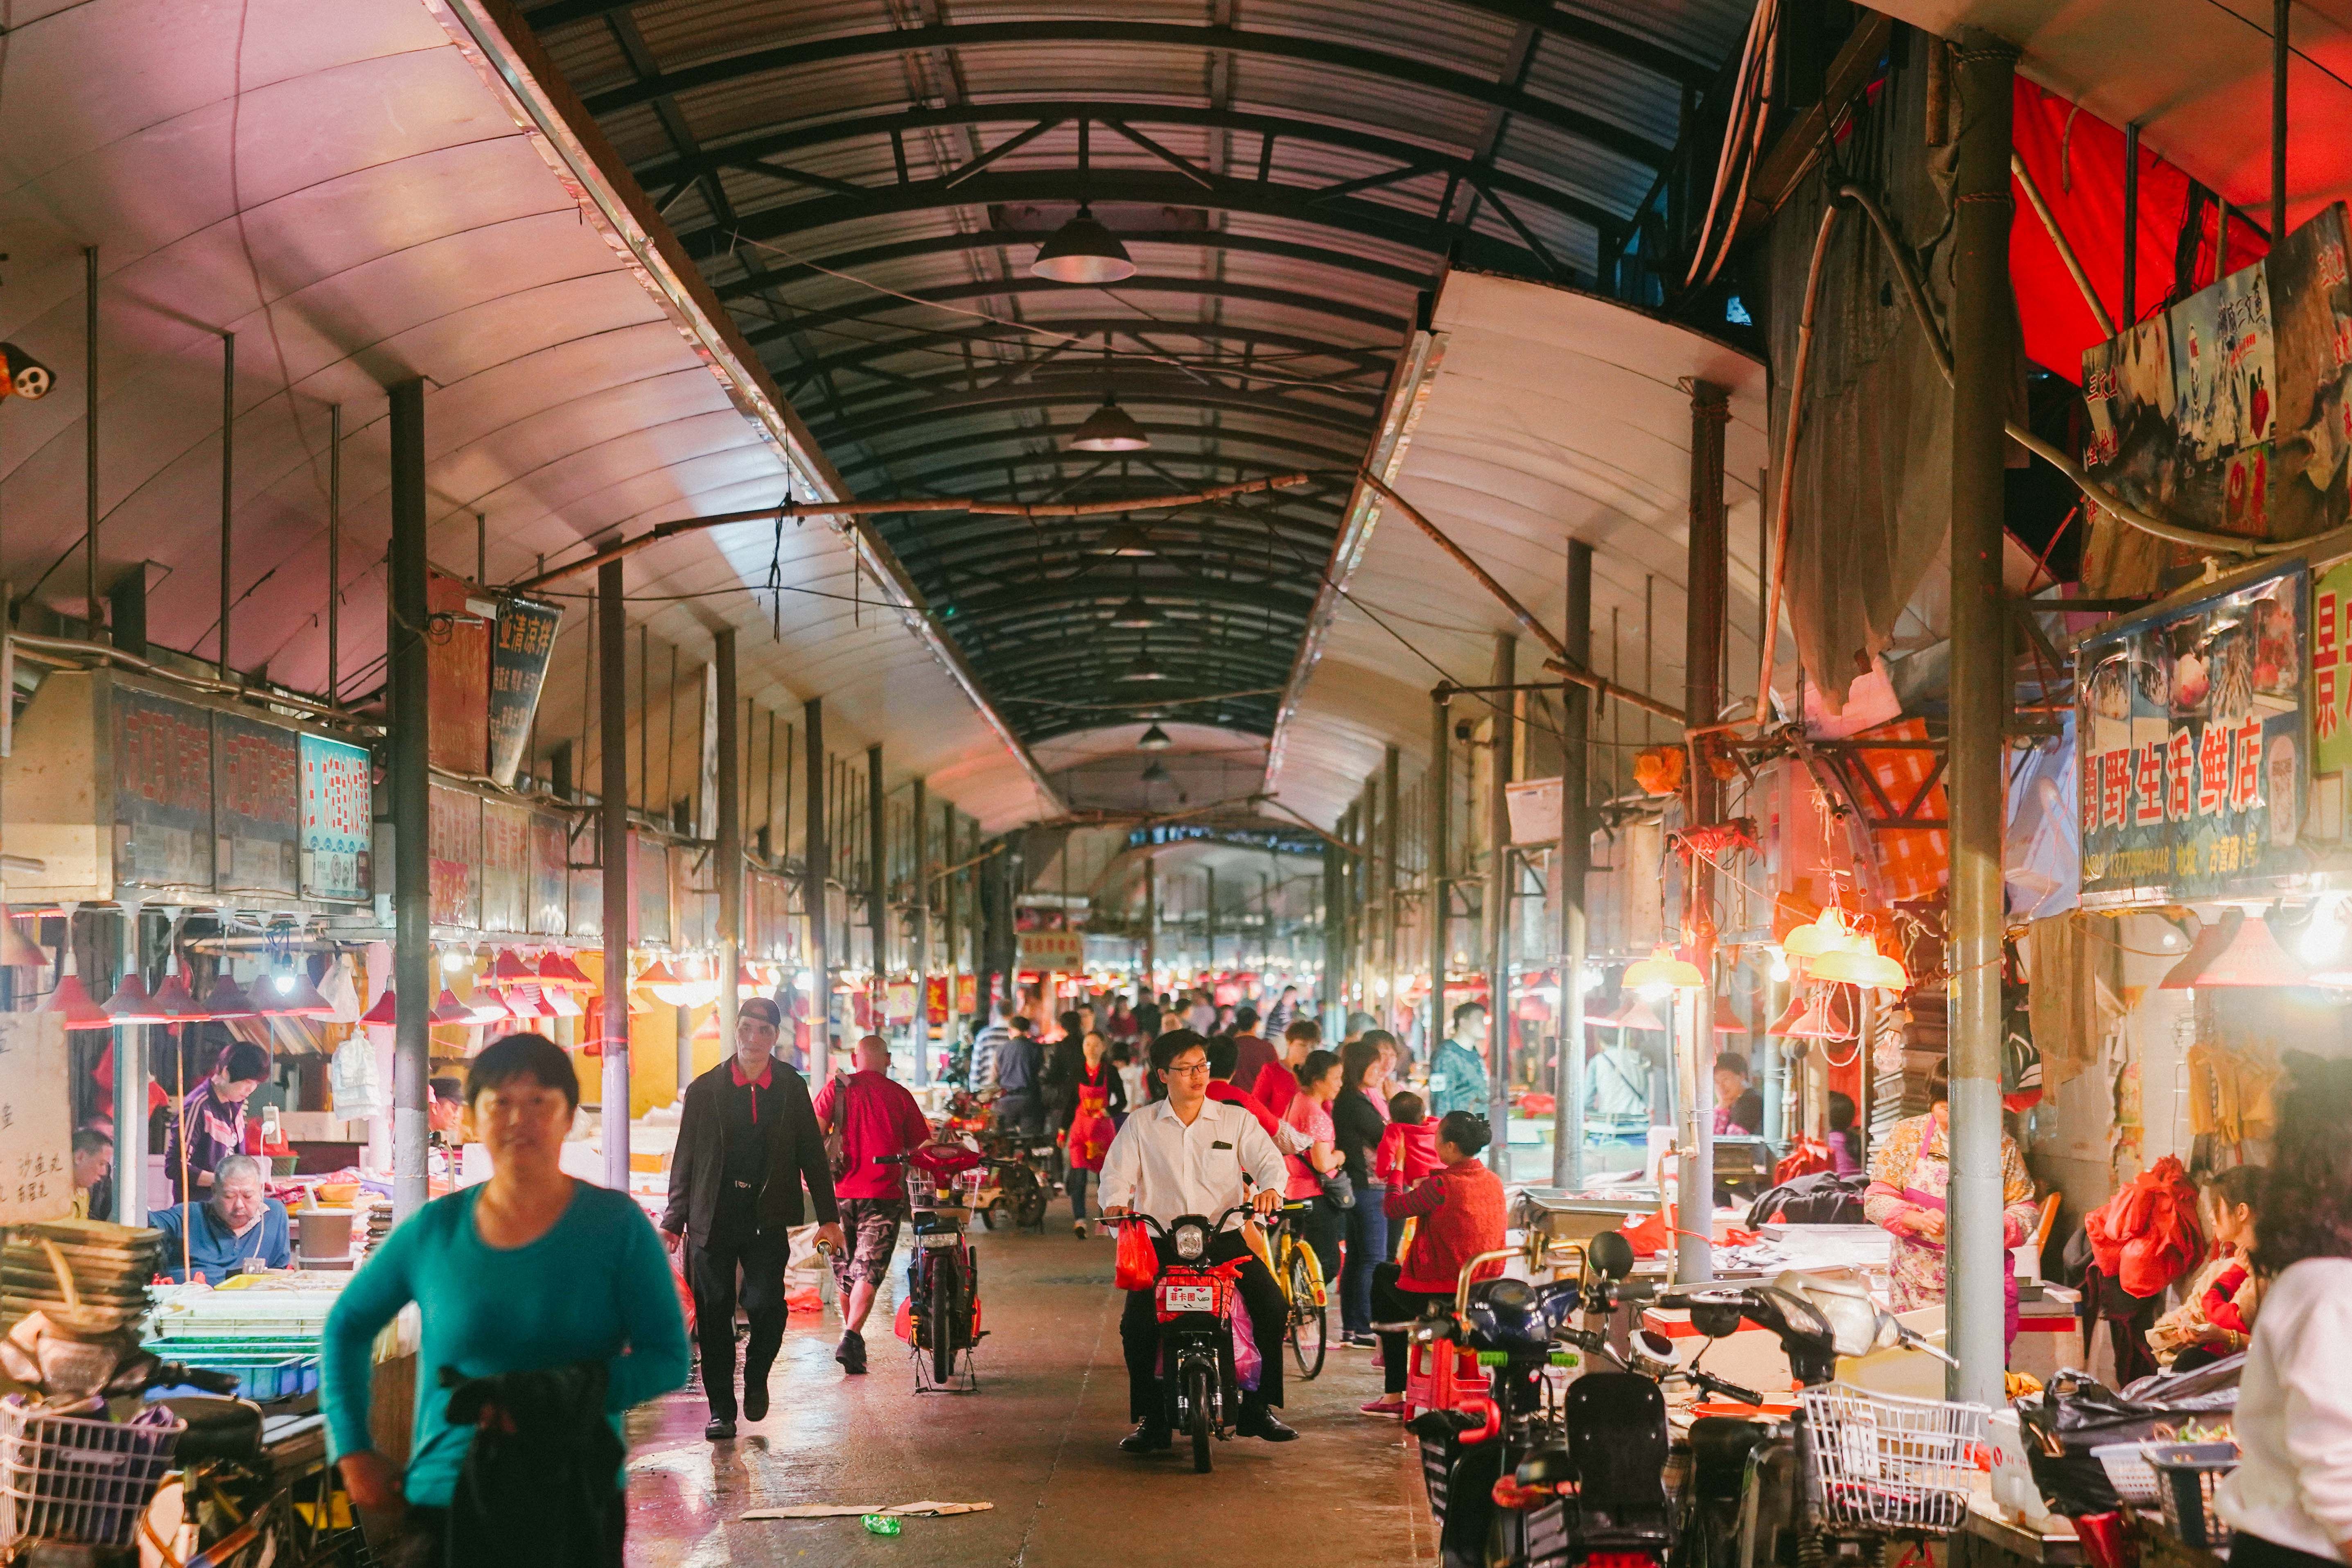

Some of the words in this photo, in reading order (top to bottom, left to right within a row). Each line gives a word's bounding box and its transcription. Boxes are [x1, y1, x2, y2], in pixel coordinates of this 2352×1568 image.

[2087, 365, 2118, 403] 三文鱼
[2314, 593, 2352, 740] 景
